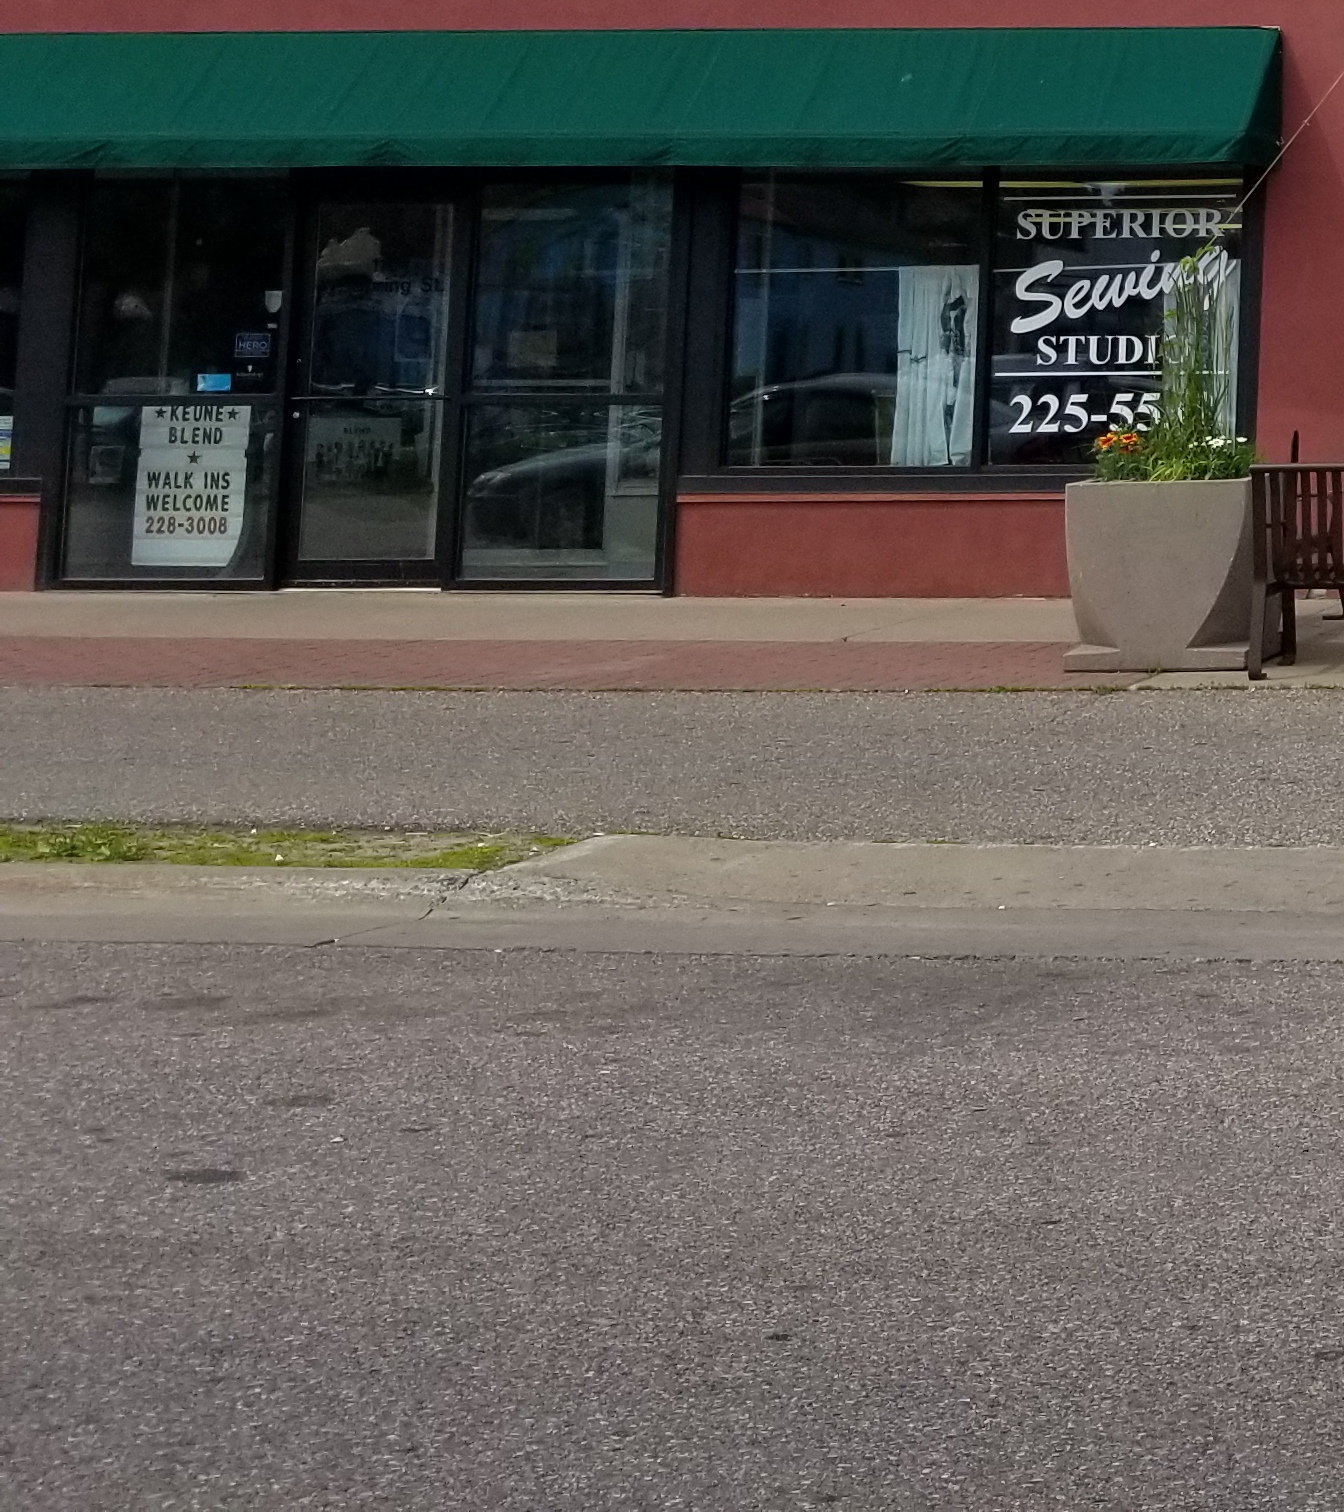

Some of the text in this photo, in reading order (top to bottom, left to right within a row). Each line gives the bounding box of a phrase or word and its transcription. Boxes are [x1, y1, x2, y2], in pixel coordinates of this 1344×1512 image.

[1016, 207, 1226, 240] SUPERIOR
[1010, 245, 1238, 334] Sewing
[238, 340, 268, 350] HERO
[170, 405, 225, 422] KEUNE
[168, 426, 223, 445] BLEND
[147, 471, 231, 490] WALK INS
[145, 494, 230, 512] WELCOME
[144, 516, 228, 534] 228-3008
